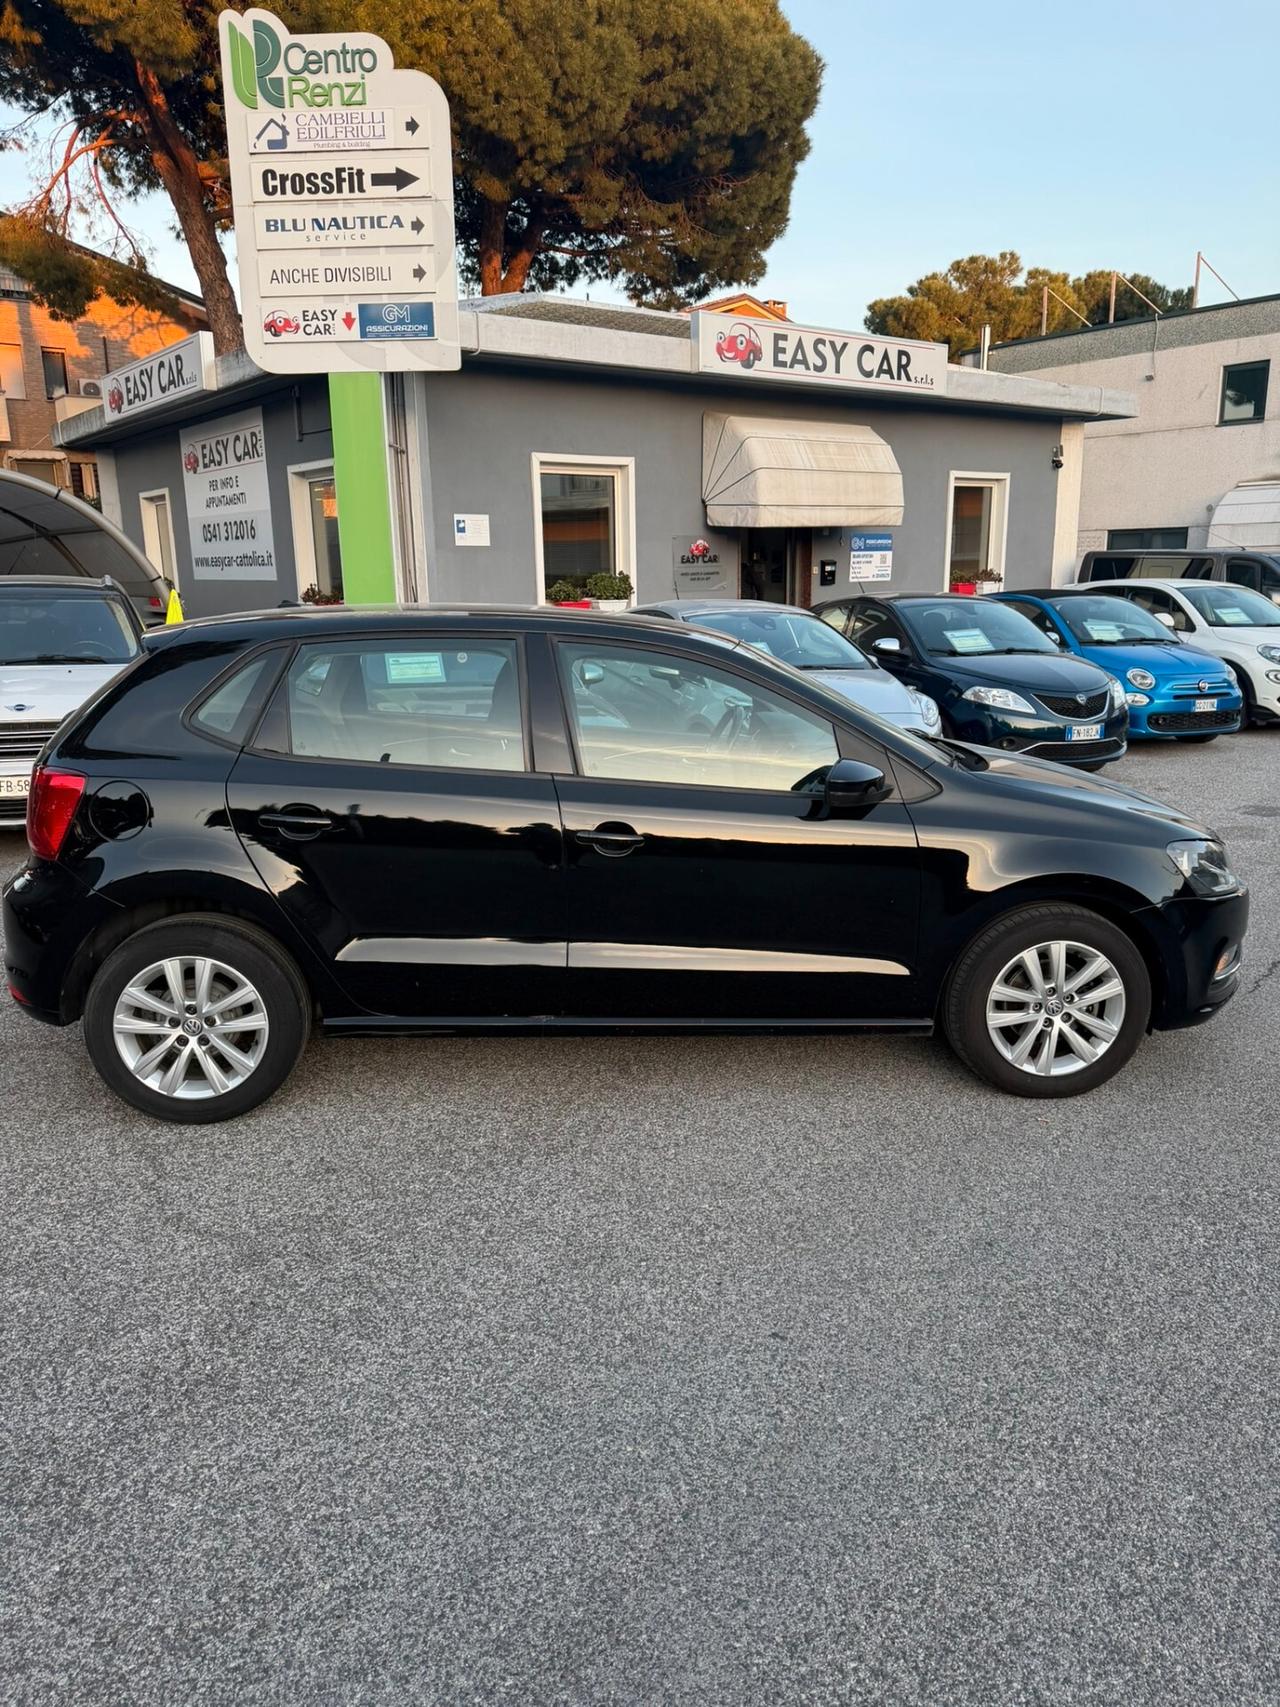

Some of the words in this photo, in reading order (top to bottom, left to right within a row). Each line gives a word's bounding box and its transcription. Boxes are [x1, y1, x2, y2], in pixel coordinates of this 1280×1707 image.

[283, 42, 378, 75] Centro
[287, 74, 367, 108] Renzi
[295, 111, 385, 127] CAMBIELLI
[297, 125, 386, 140] EDILFRIULI
[261, 166, 366, 197] CrossFit
[265, 218, 306, 233] BLU
[311, 215, 405, 231] NAUTICA
[306, 232, 367, 242] service
[270, 268, 320, 285] ANCHE
[324, 266, 392, 283] DIVISIBILI
[302, 309, 338, 322] EASY
[303, 323, 332, 336] CAR
[366, 324, 429, 333] ASSICURAZIONI
[773, 332, 849, 374] EASY
[857, 343, 912, 382] CAR
[124, 362, 154, 407] EASY
[157, 353, 186, 394] CAR
[201, 436, 229, 470] EASY
[233, 430, 261, 463] CAR
[208, 479, 219, 492] PER
[220, 476, 234, 490] INFO
[234, 475, 239, 488] E
[205, 492, 247, 509] APPUNTAMENTI
[202, 523, 222, 543] 0541
[224, 519, 256, 541] 312016
[194, 550, 273, 571] www.easycar-cattolica.it
[702, 553, 718, 563] CAR
